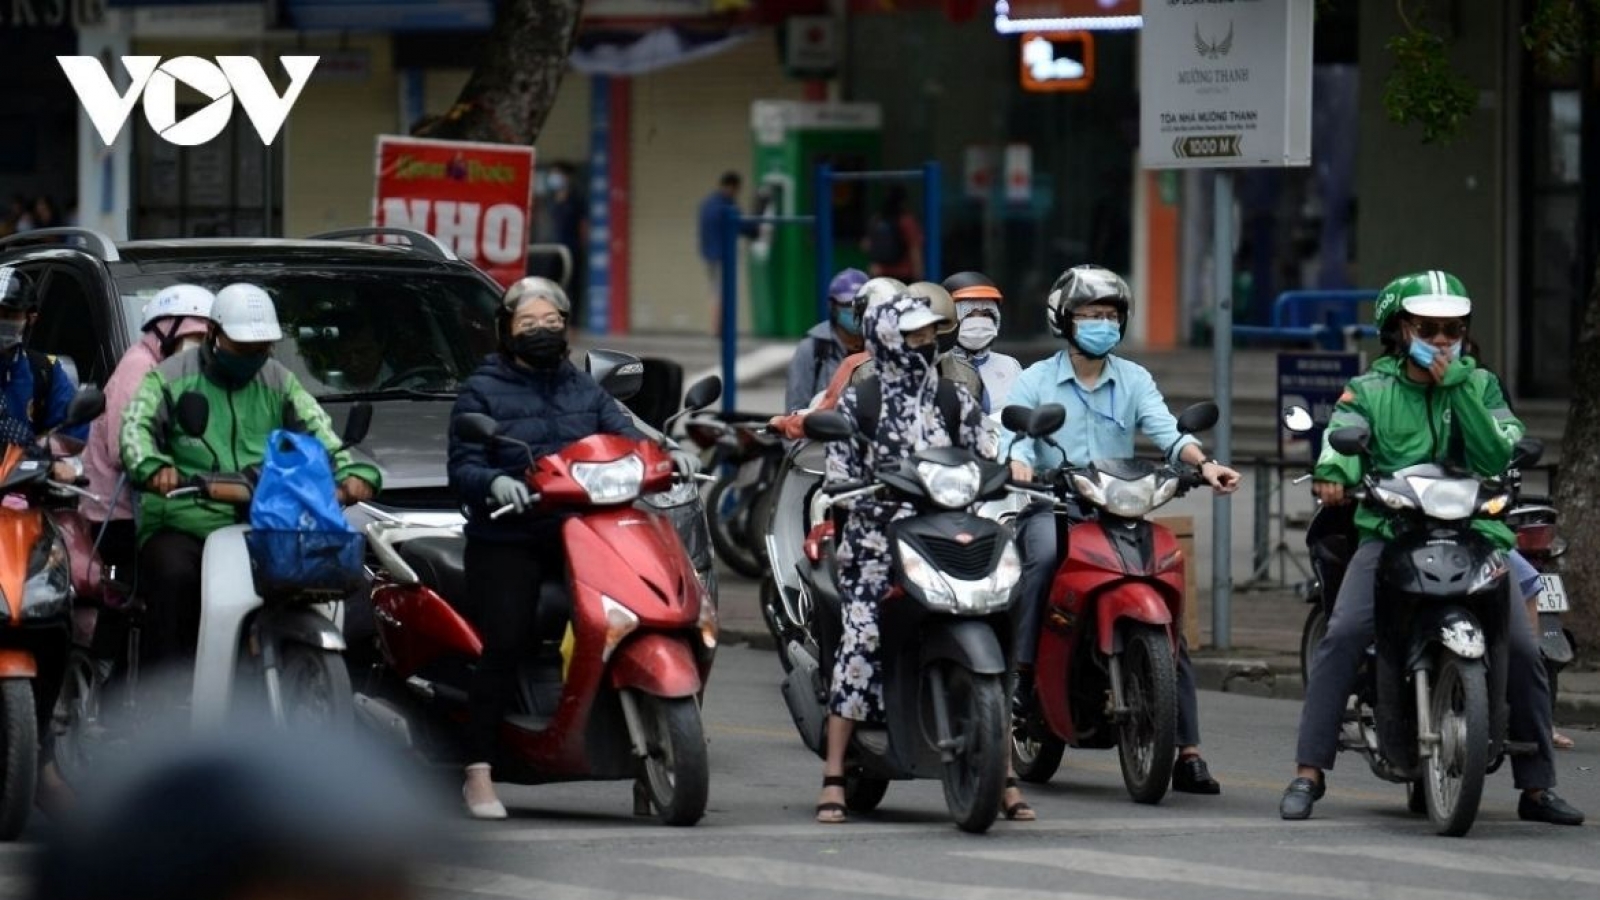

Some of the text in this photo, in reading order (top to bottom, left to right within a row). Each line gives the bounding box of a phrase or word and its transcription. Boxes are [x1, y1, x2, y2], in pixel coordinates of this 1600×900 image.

[1214, 68, 1249, 83] THANH
[1230, 109, 1258, 121] THANH
[1189, 138, 1230, 154] 1000 M
